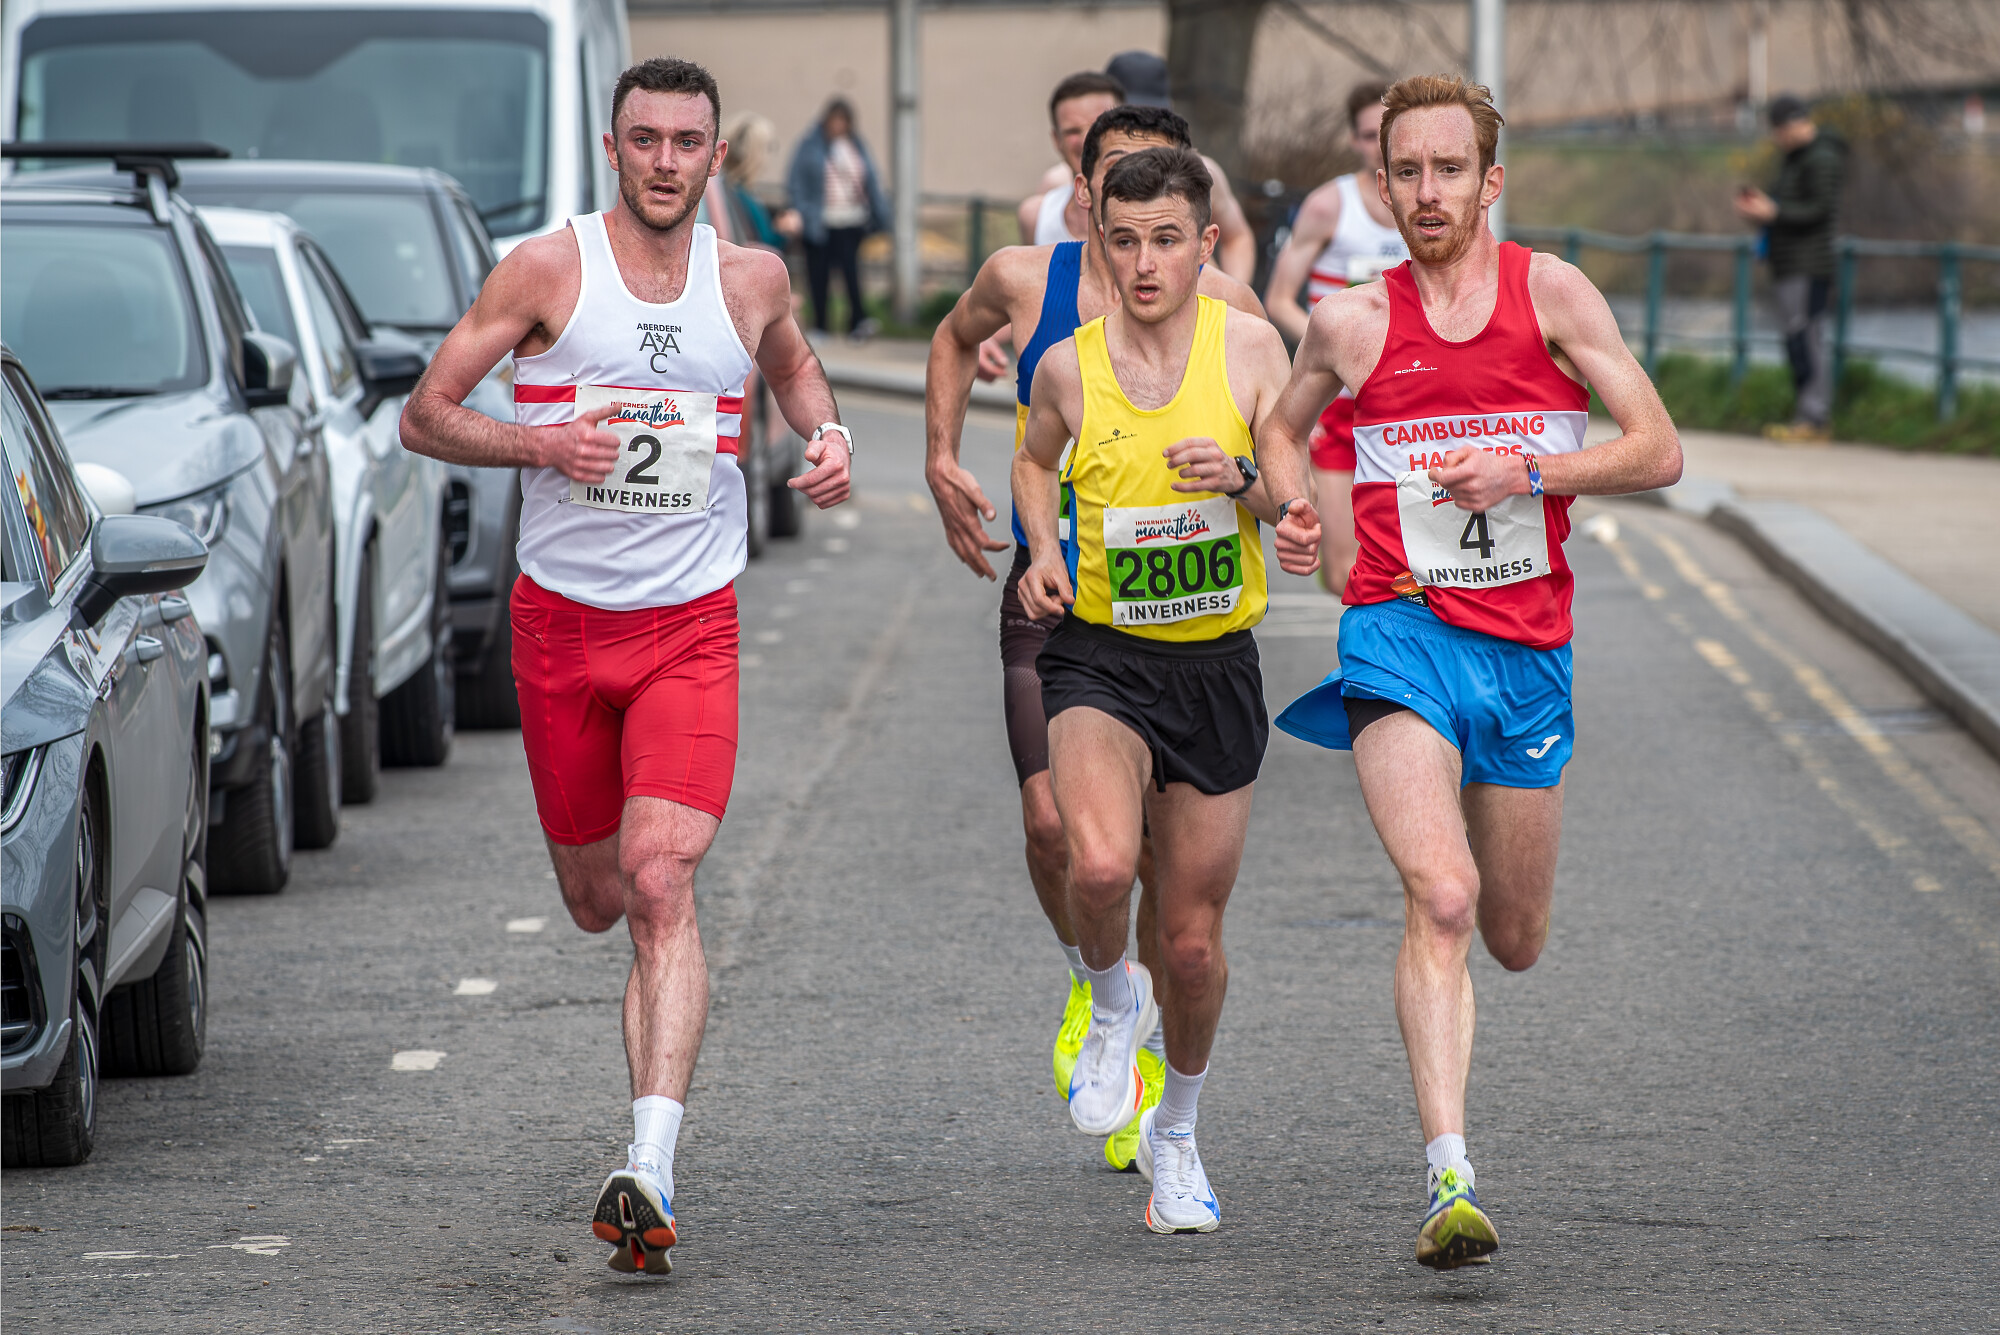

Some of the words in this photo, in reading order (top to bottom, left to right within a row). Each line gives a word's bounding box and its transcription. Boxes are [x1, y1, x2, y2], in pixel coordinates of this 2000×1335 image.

[636, 322, 682, 333] ABERDEEN
[1382, 415, 1545, 446] CAMBUSLANG
[624, 434, 662, 485] 2
[586, 486, 692, 508] INVERNESS
[1135, 518, 1171, 526] INVERNESS
[1135, 513, 1209, 541] marathon
[1459, 511, 1495, 559] 4
[1115, 539, 1235, 598] 2806
[1428, 557, 1533, 583] INVERNESS
[1129, 594, 1230, 620] INVERNESS
